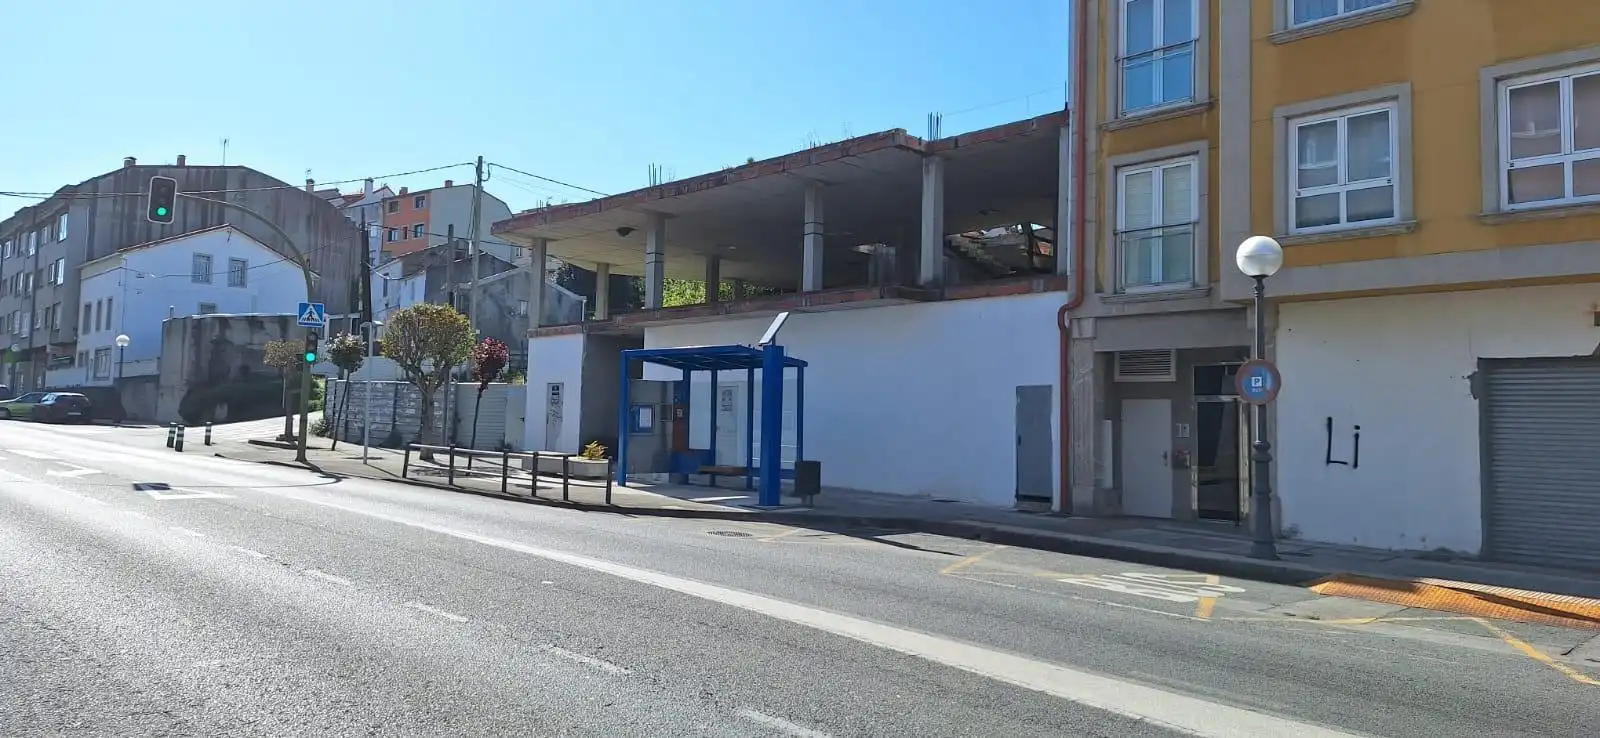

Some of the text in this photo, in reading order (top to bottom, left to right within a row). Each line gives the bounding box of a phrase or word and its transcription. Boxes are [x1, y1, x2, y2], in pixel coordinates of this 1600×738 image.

[1253, 377, 1261, 386] P
[1325, 416, 1361, 469] Li
[1057, 572, 1246, 603] BUS
